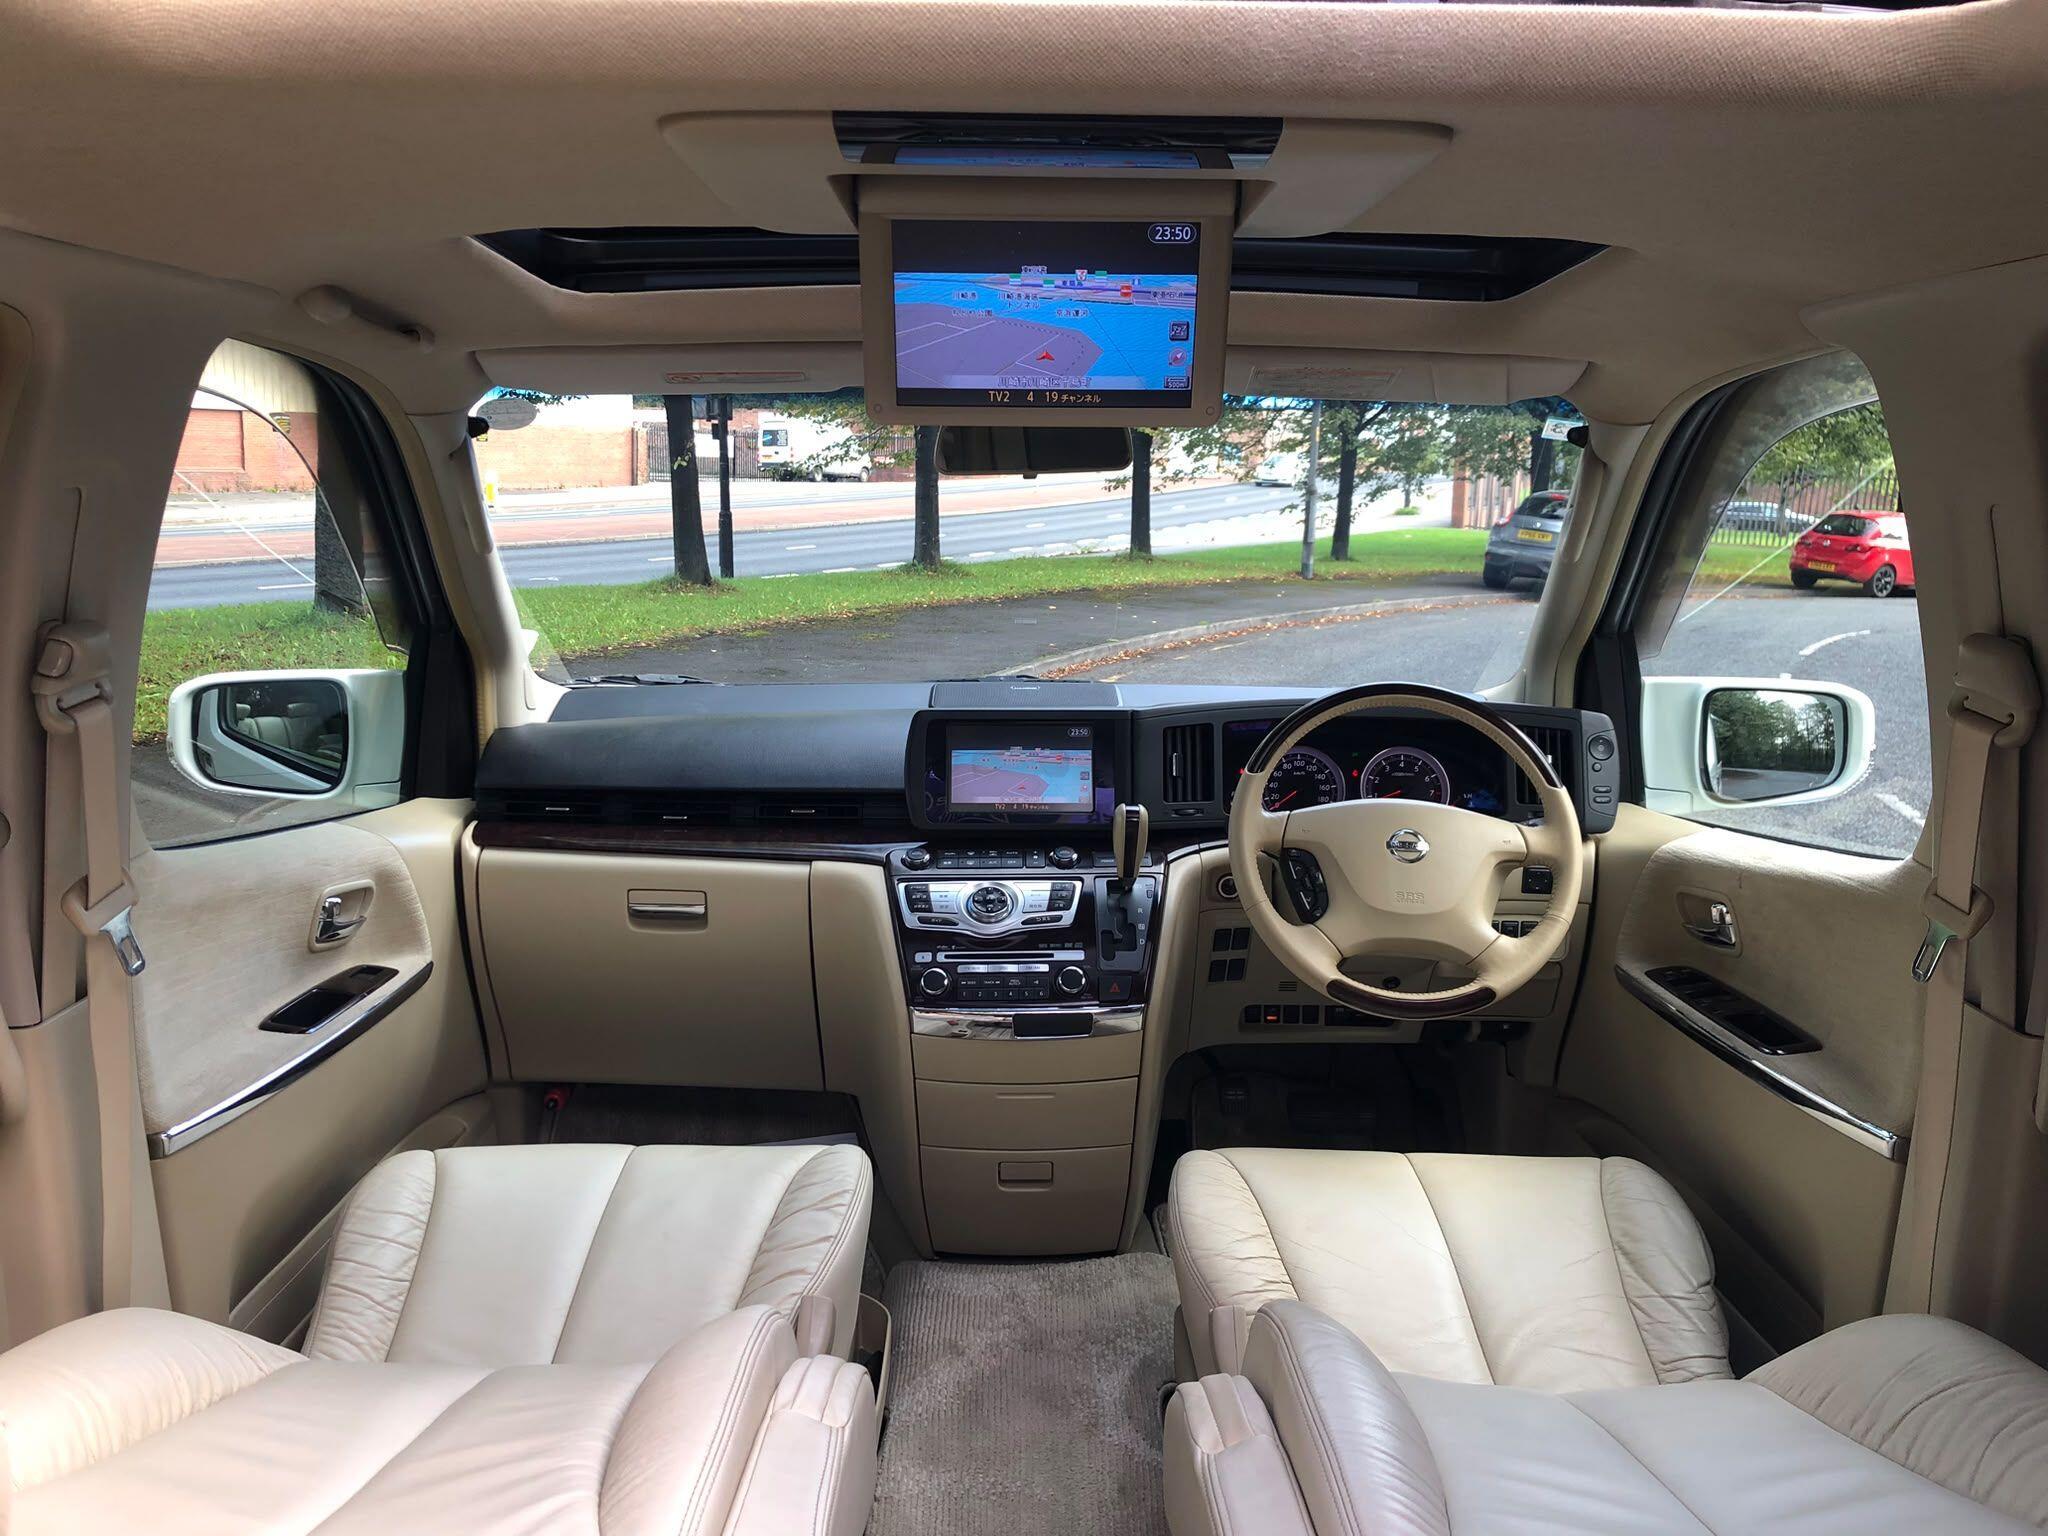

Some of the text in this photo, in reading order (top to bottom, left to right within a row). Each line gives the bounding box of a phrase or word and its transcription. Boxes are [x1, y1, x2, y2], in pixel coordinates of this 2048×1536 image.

[1155, 226, 1191, 240] 23:50
[988, 391, 1101, 403] TV2 4 19 チャンネル
